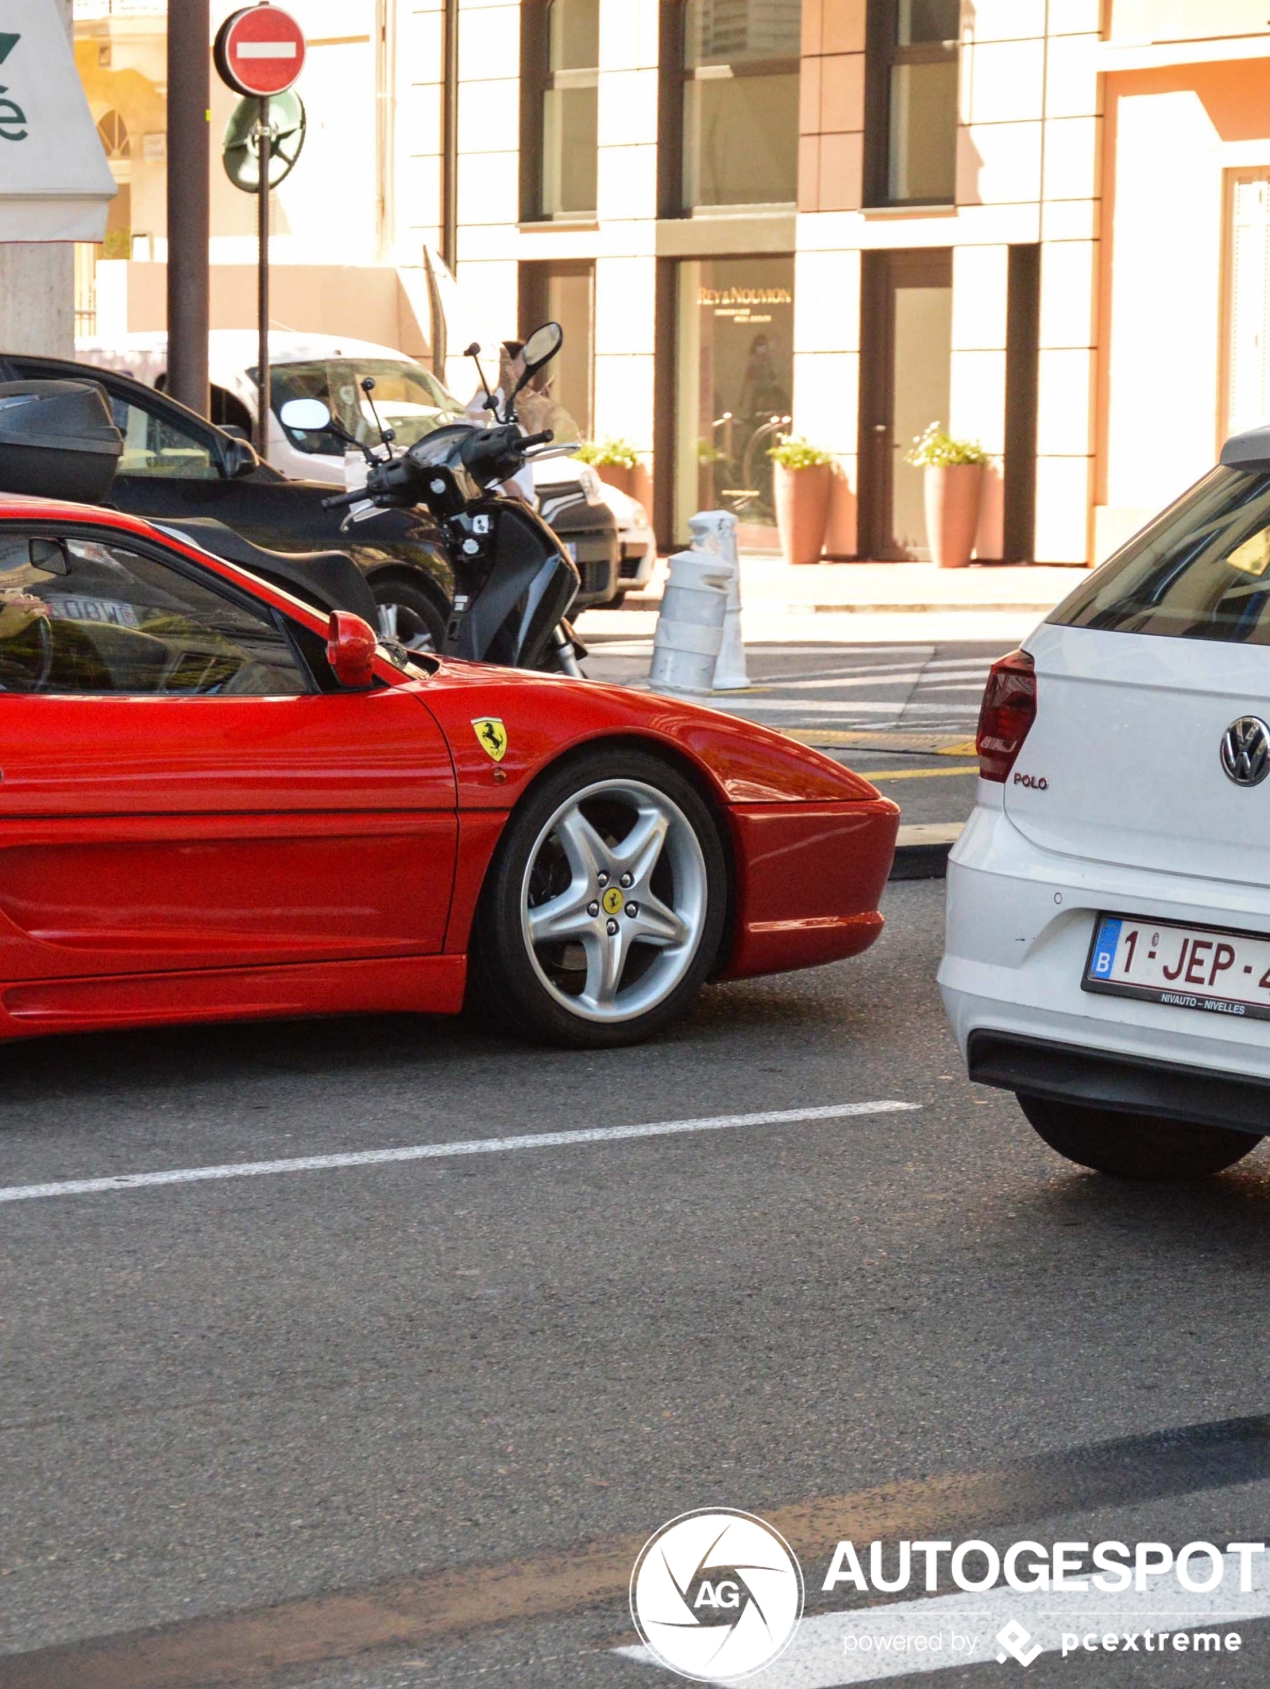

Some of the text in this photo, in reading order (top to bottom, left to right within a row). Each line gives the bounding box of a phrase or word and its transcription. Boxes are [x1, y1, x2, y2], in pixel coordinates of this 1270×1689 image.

[1013, 773, 1049, 791] POLO
[1096, 952, 1111, 973] B
[1161, 993, 1197, 1007] NIVAUTO
[1204, 1000, 1245, 1015] NIVELLES
